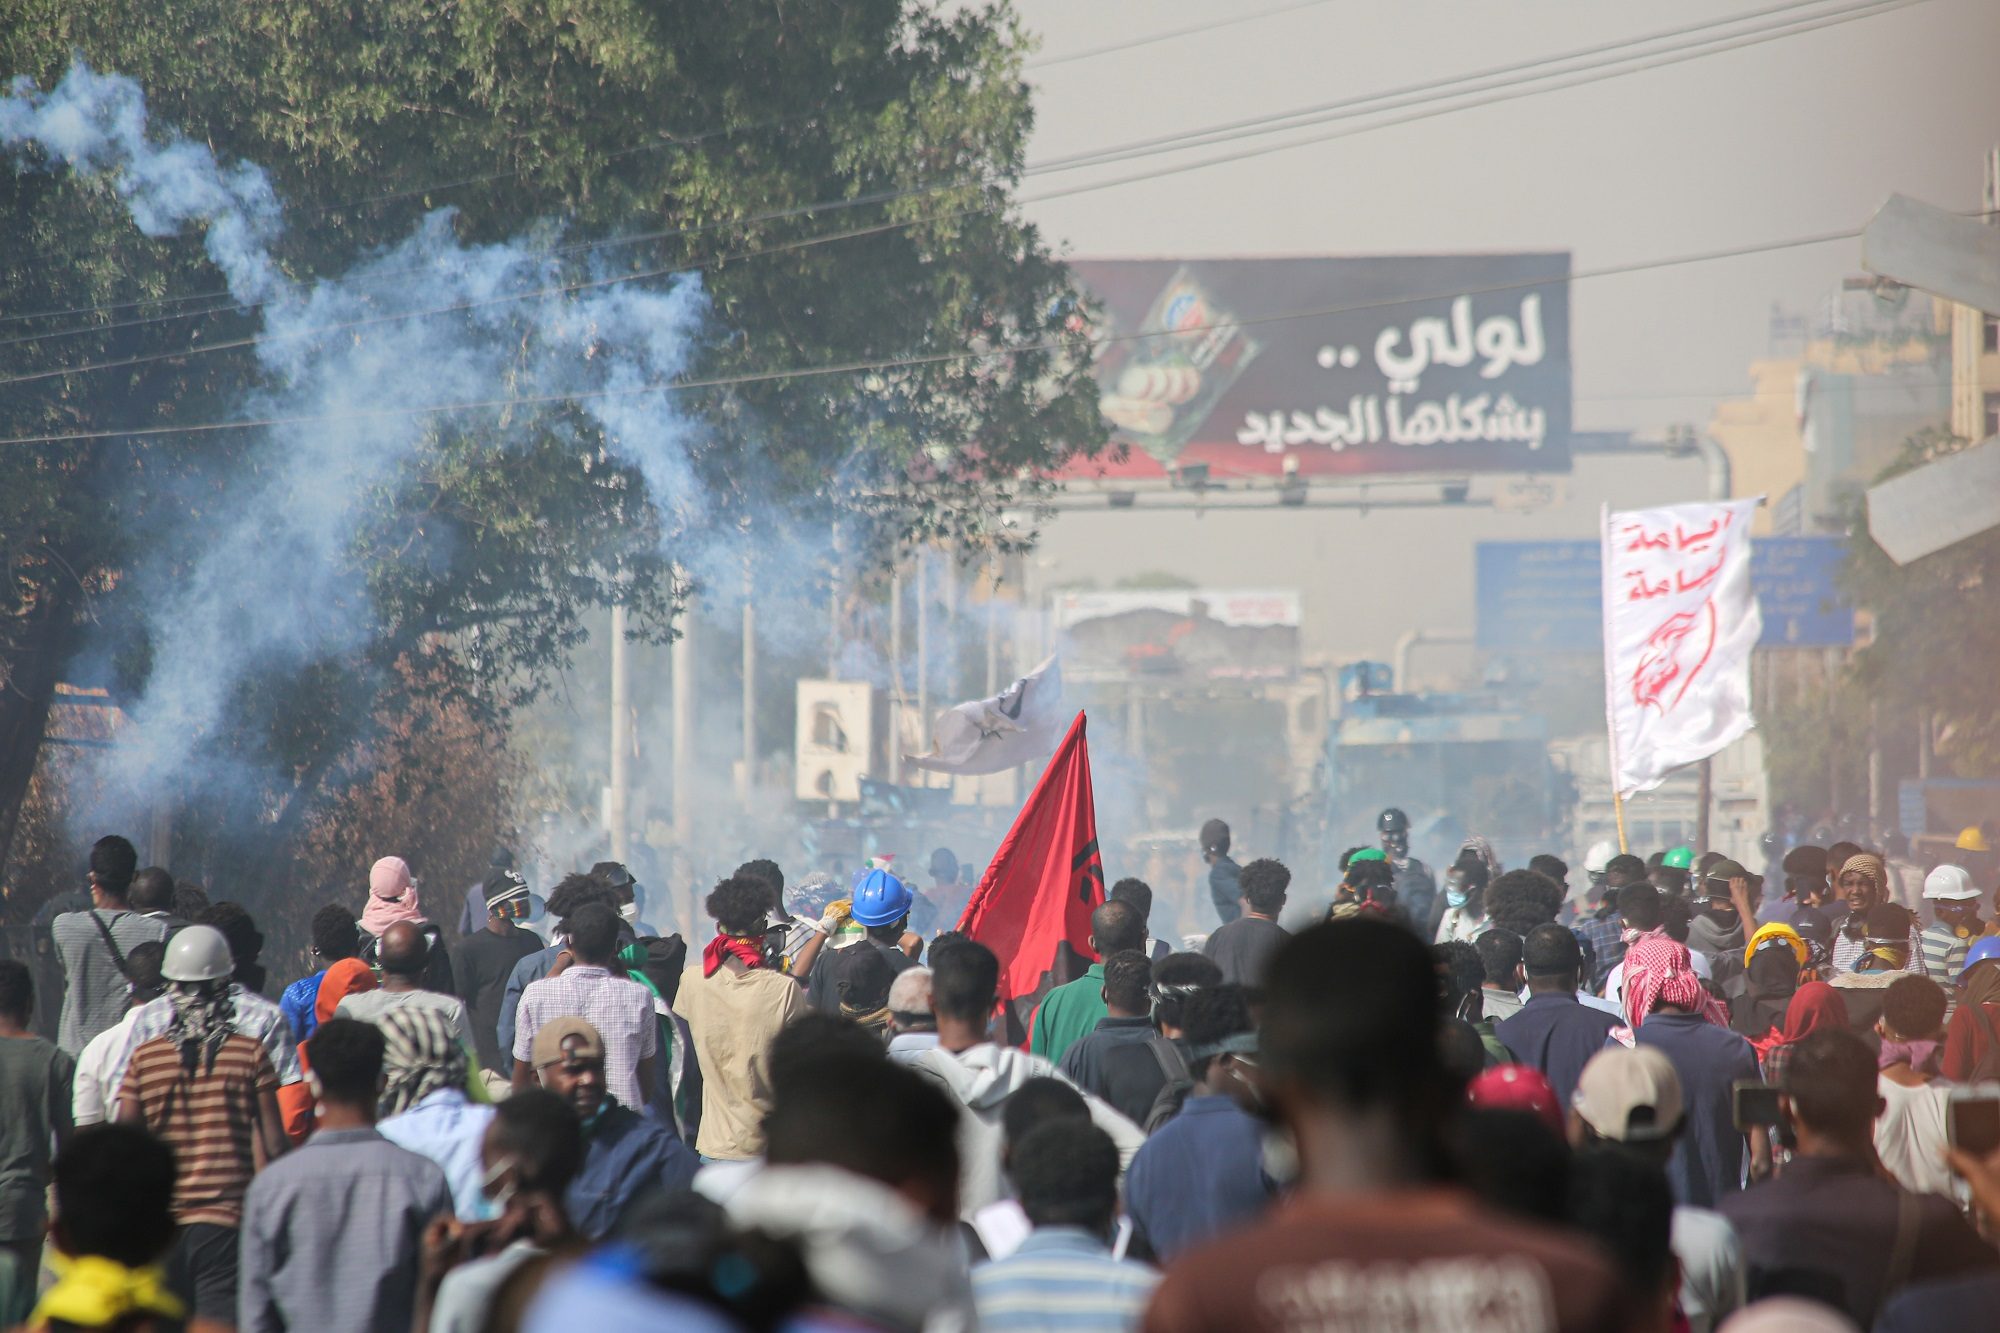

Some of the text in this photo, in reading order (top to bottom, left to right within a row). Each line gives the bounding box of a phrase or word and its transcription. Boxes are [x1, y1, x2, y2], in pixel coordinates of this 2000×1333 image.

[1374, 294, 1545, 394] لولي
[1236, 392, 1546, 454] بشكلها الجديد
